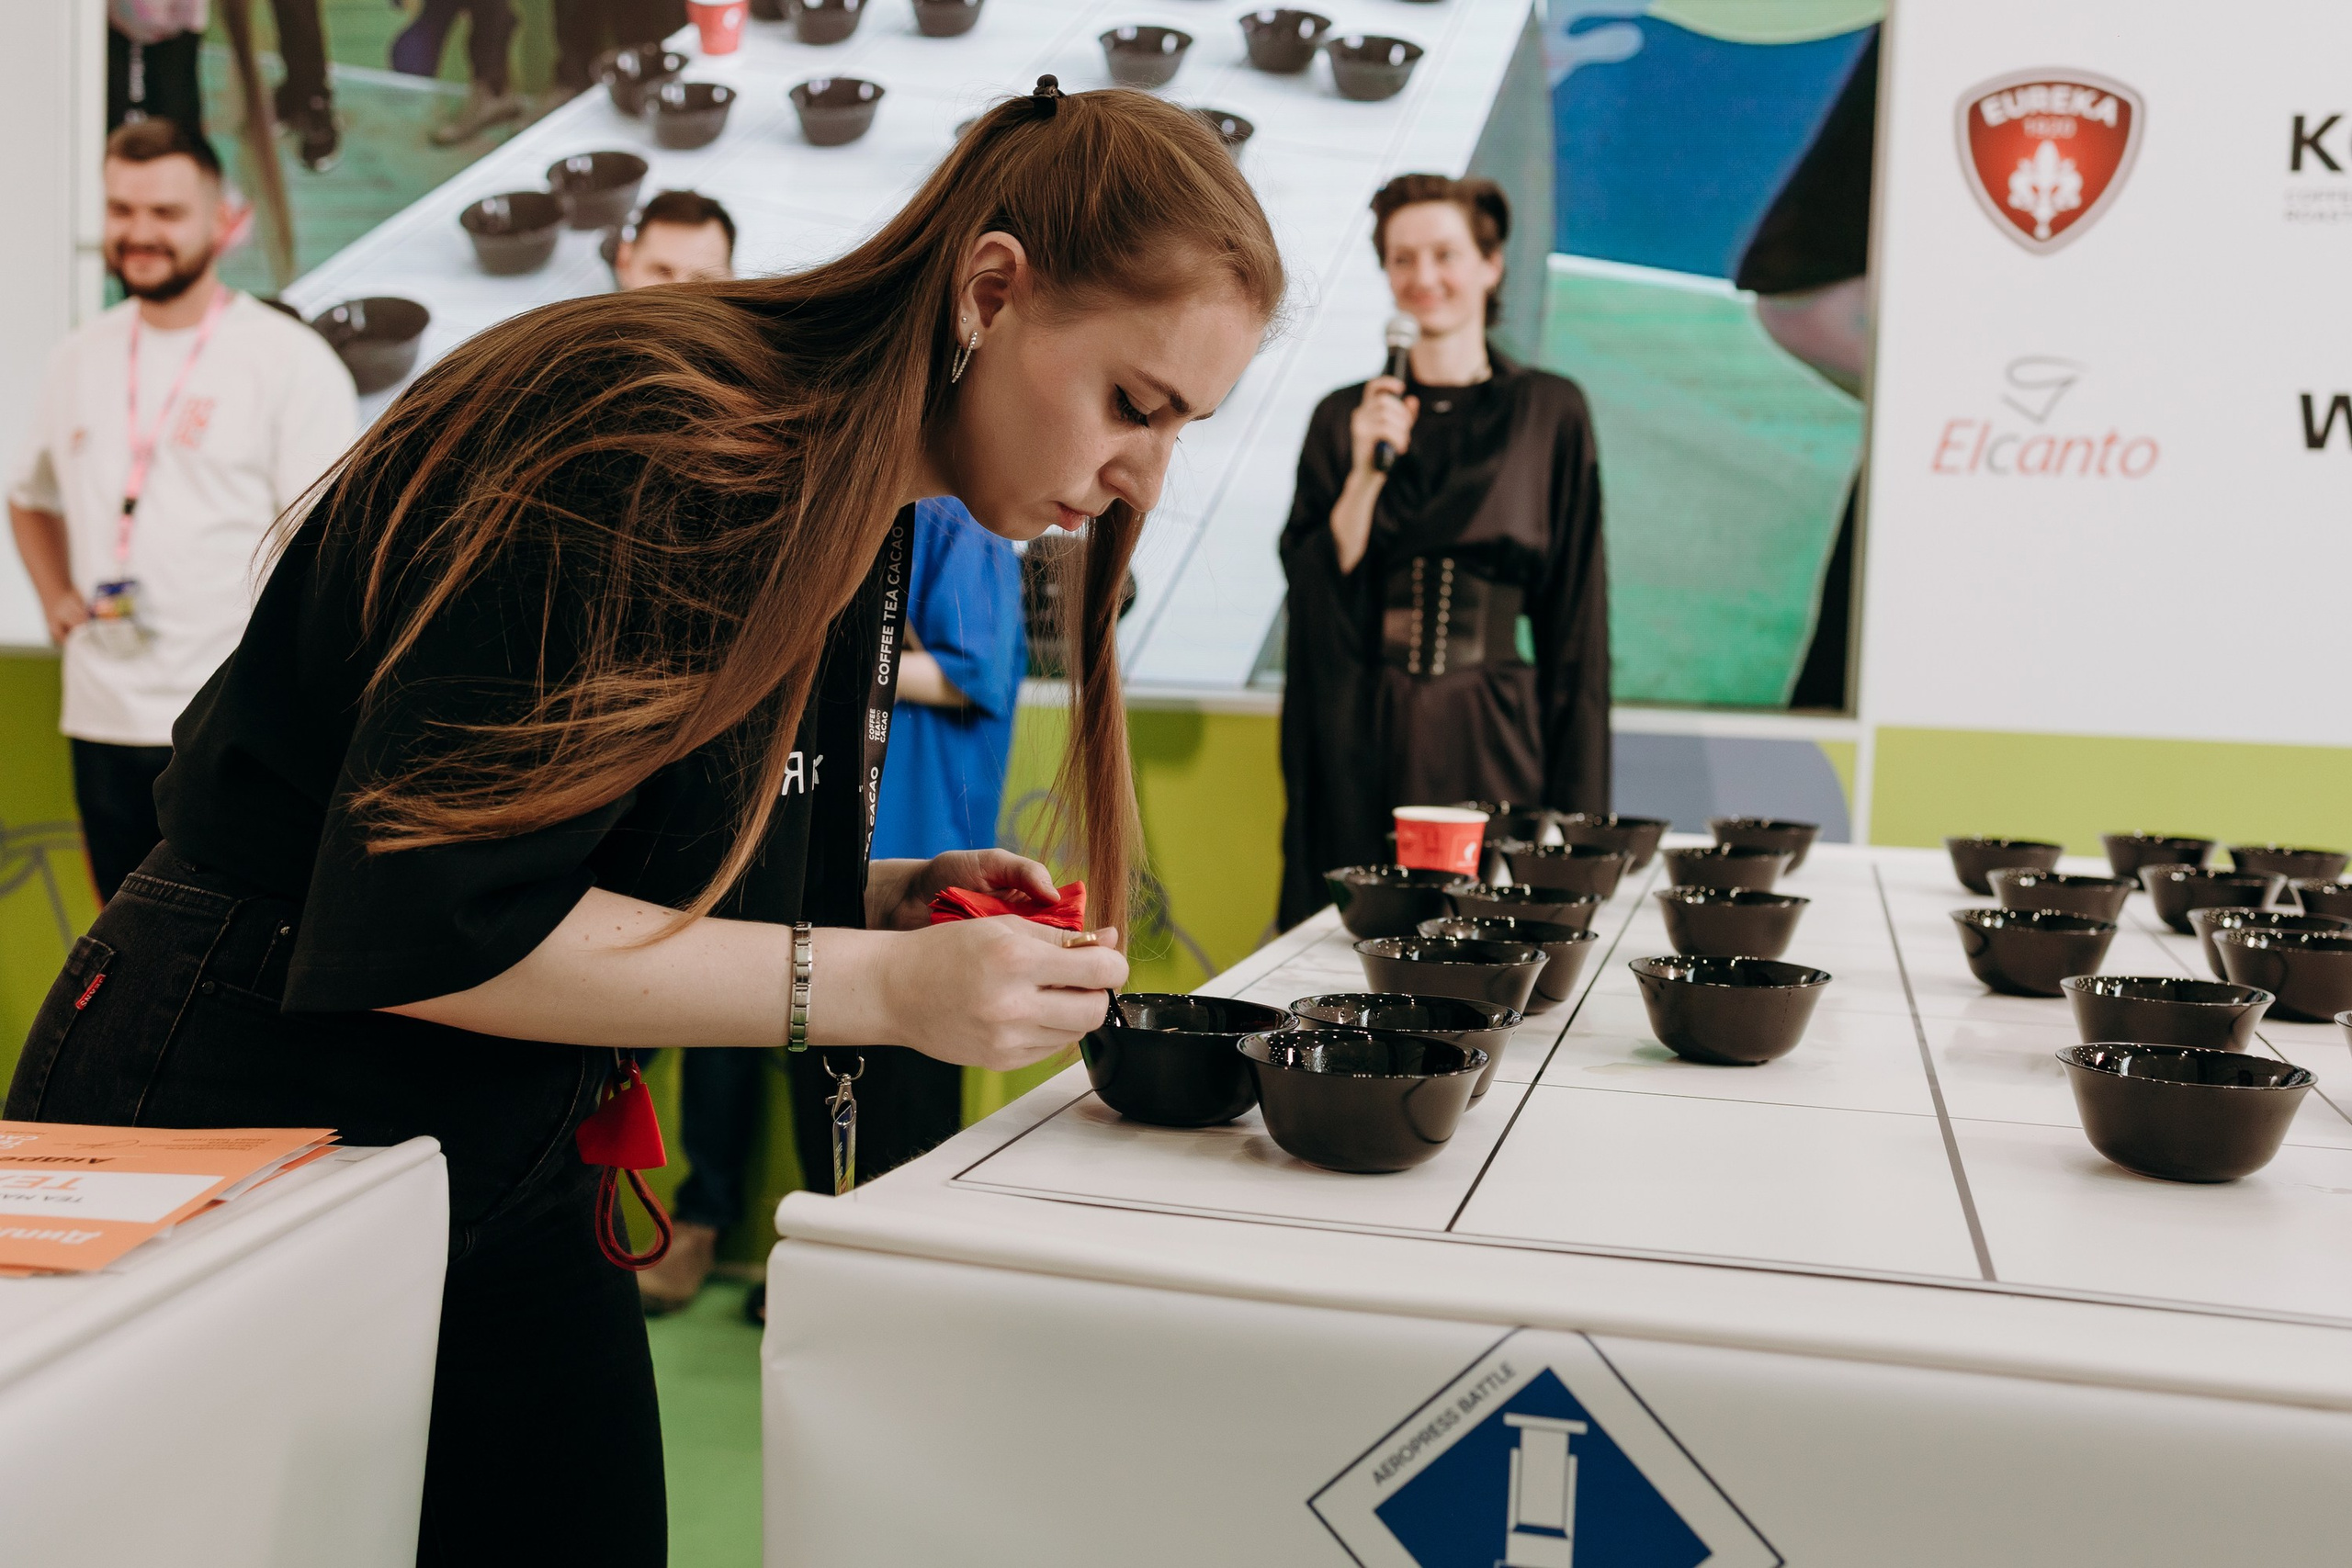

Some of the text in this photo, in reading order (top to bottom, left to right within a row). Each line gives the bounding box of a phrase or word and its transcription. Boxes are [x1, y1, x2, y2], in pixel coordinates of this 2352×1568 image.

[1979, 84, 2119, 128] EUREKA
[2290, 114, 2352, 172] K
[1930, 418, 2161, 479] Elcanto
[877, 525, 904, 685] COFFEE TEA CACAO
[879, 711, 888, 743] CACAO
[869, 766, 879, 827] CACAO
[1373, 1359, 1516, 1486] AEROPRESS BATTLE
